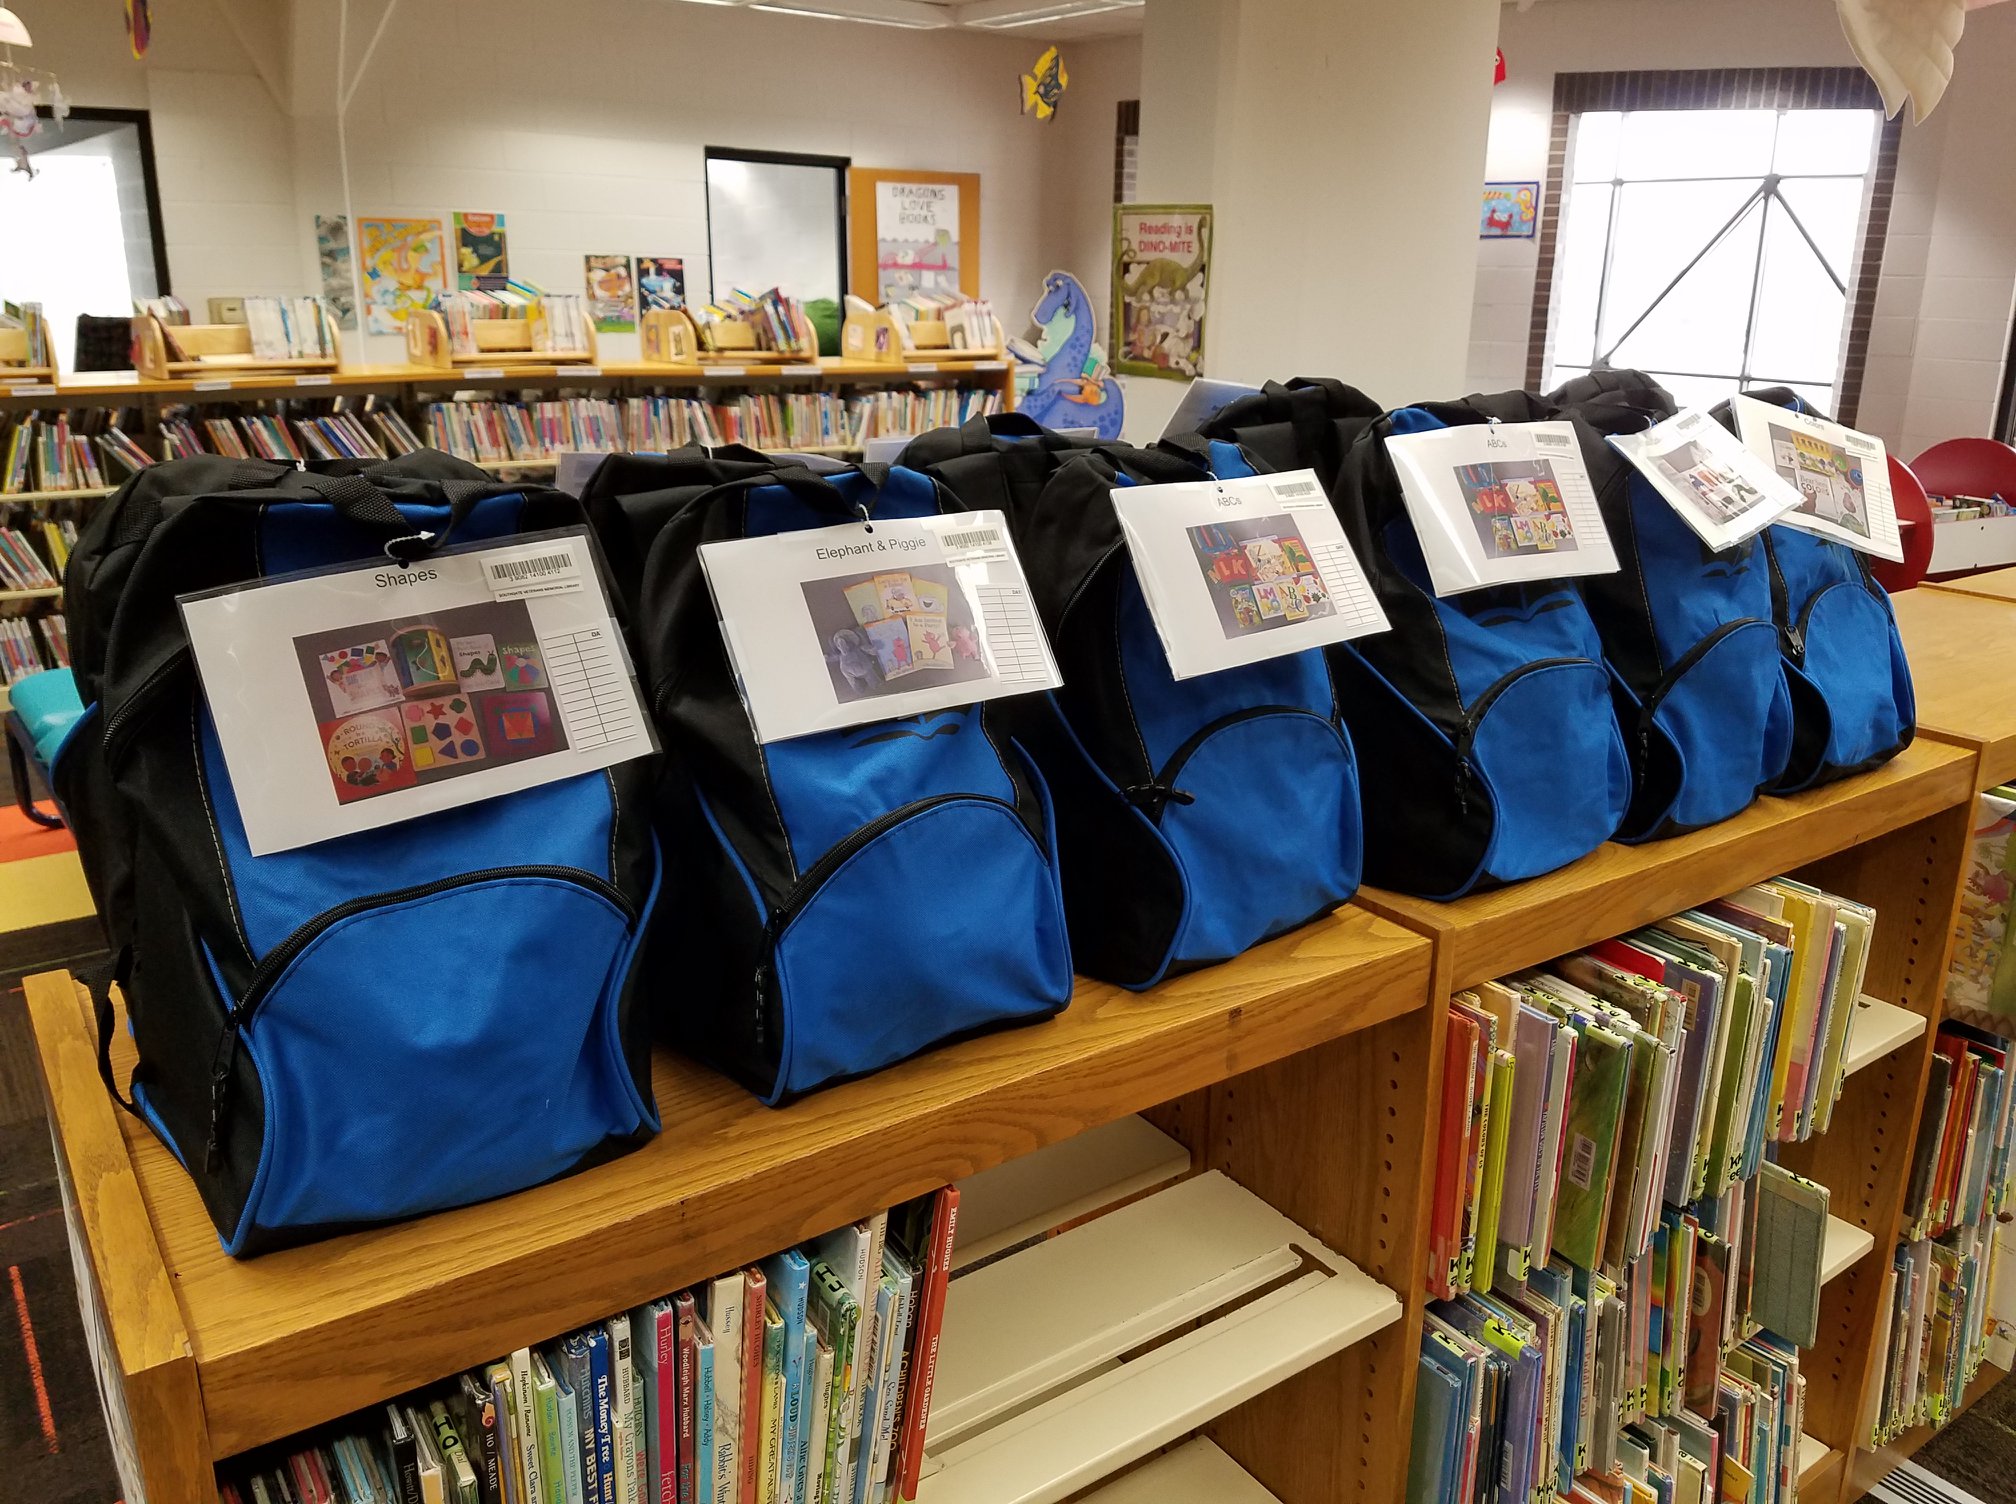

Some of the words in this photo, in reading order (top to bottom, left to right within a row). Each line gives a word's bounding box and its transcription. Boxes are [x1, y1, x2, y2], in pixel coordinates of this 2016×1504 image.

[892, 187, 946, 200] DRAGONS
[901, 200, 934, 212] LOVE
[1139, 222, 1182, 238] Reading
[1185, 222, 1193, 234] is
[1138, 240, 1193, 253] DINO-MITE
[1487, 439, 1507, 448] ABCs
[1217, 496, 1242, 507] ABCs
[816, 541, 874, 560] Elephant
[877, 539, 886, 551] &
[889, 537, 926, 551] Piggie
[375, 569, 438, 588] Shapes
[1232, 559, 1246, 575] K
[502, 644, 536, 656] shapes
[343, 736, 383, 751] TORTILLA
[947, 1207, 958, 1235] EMILY
[857, 1248, 867, 1281] HUDSON
[943, 1235, 953, 1271] HUGHES
[1449, 1258, 1459, 1273] K
[722, 1306, 735, 1333] Hussey
[754, 1294, 762, 1331] SHIRLEY
[796, 1296, 805, 1325] HUDSON
[1492, 1323, 1505, 1336] K
[659, 1326, 671, 1365] Hurley
[752, 1333, 761, 1368] HUGHES
[930, 1334, 939, 1354] THE
[681, 1347, 690, 1386] Woodleigh
[704, 1366, 713, 1393] Hubbell
[925, 1354, 935, 1386] LITTLE
[1582, 1352, 1591, 1390] Puddle
[520, 1370, 530, 1404] Hopkinson
[581, 1368, 593, 1420] Hutchins
[597, 1375, 608, 1398] The
[621, 1368, 631, 1404] HUBBARD
[682, 1387, 690, 1406] Marx
[823, 1381, 832, 1409] Hughes
[598, 1398, 610, 1434] Money
[623, 1411, 634, 1429] My
[633, 1397, 643, 1437] HUTCHINS
[702, 1399, 712, 1422] Halsey
[789, 1391, 799, 1422] LOUD
[919, 1387, 930, 1430] GARDENER
[1580, 1395, 1588, 1418] Pail
[522, 1409, 532, 1437] Ransome
[682, 1407, 690, 1438] Hubbard
[485, 1433, 494, 1447] HO
[585, 1427, 595, 1449] MY
[601, 1435, 611, 1463] Tree
[702, 1428, 712, 1446] Addy
[525, 1444, 536, 1470] Sweet
[624, 1433, 635, 1478] Crayons
[718, 1442, 734, 1480] Rabbit's
[800, 1440, 808, 1464] Alfie
[488, 1458, 497, 1491] MEADE
[527, 1471, 538, 1494] Clara
[586, 1453, 598, 1490] BEST
[796, 1465, 806, 1493] Gives
[627, 1478, 638, 1504] Talk
[813, 1472, 823, 1500] Moving
